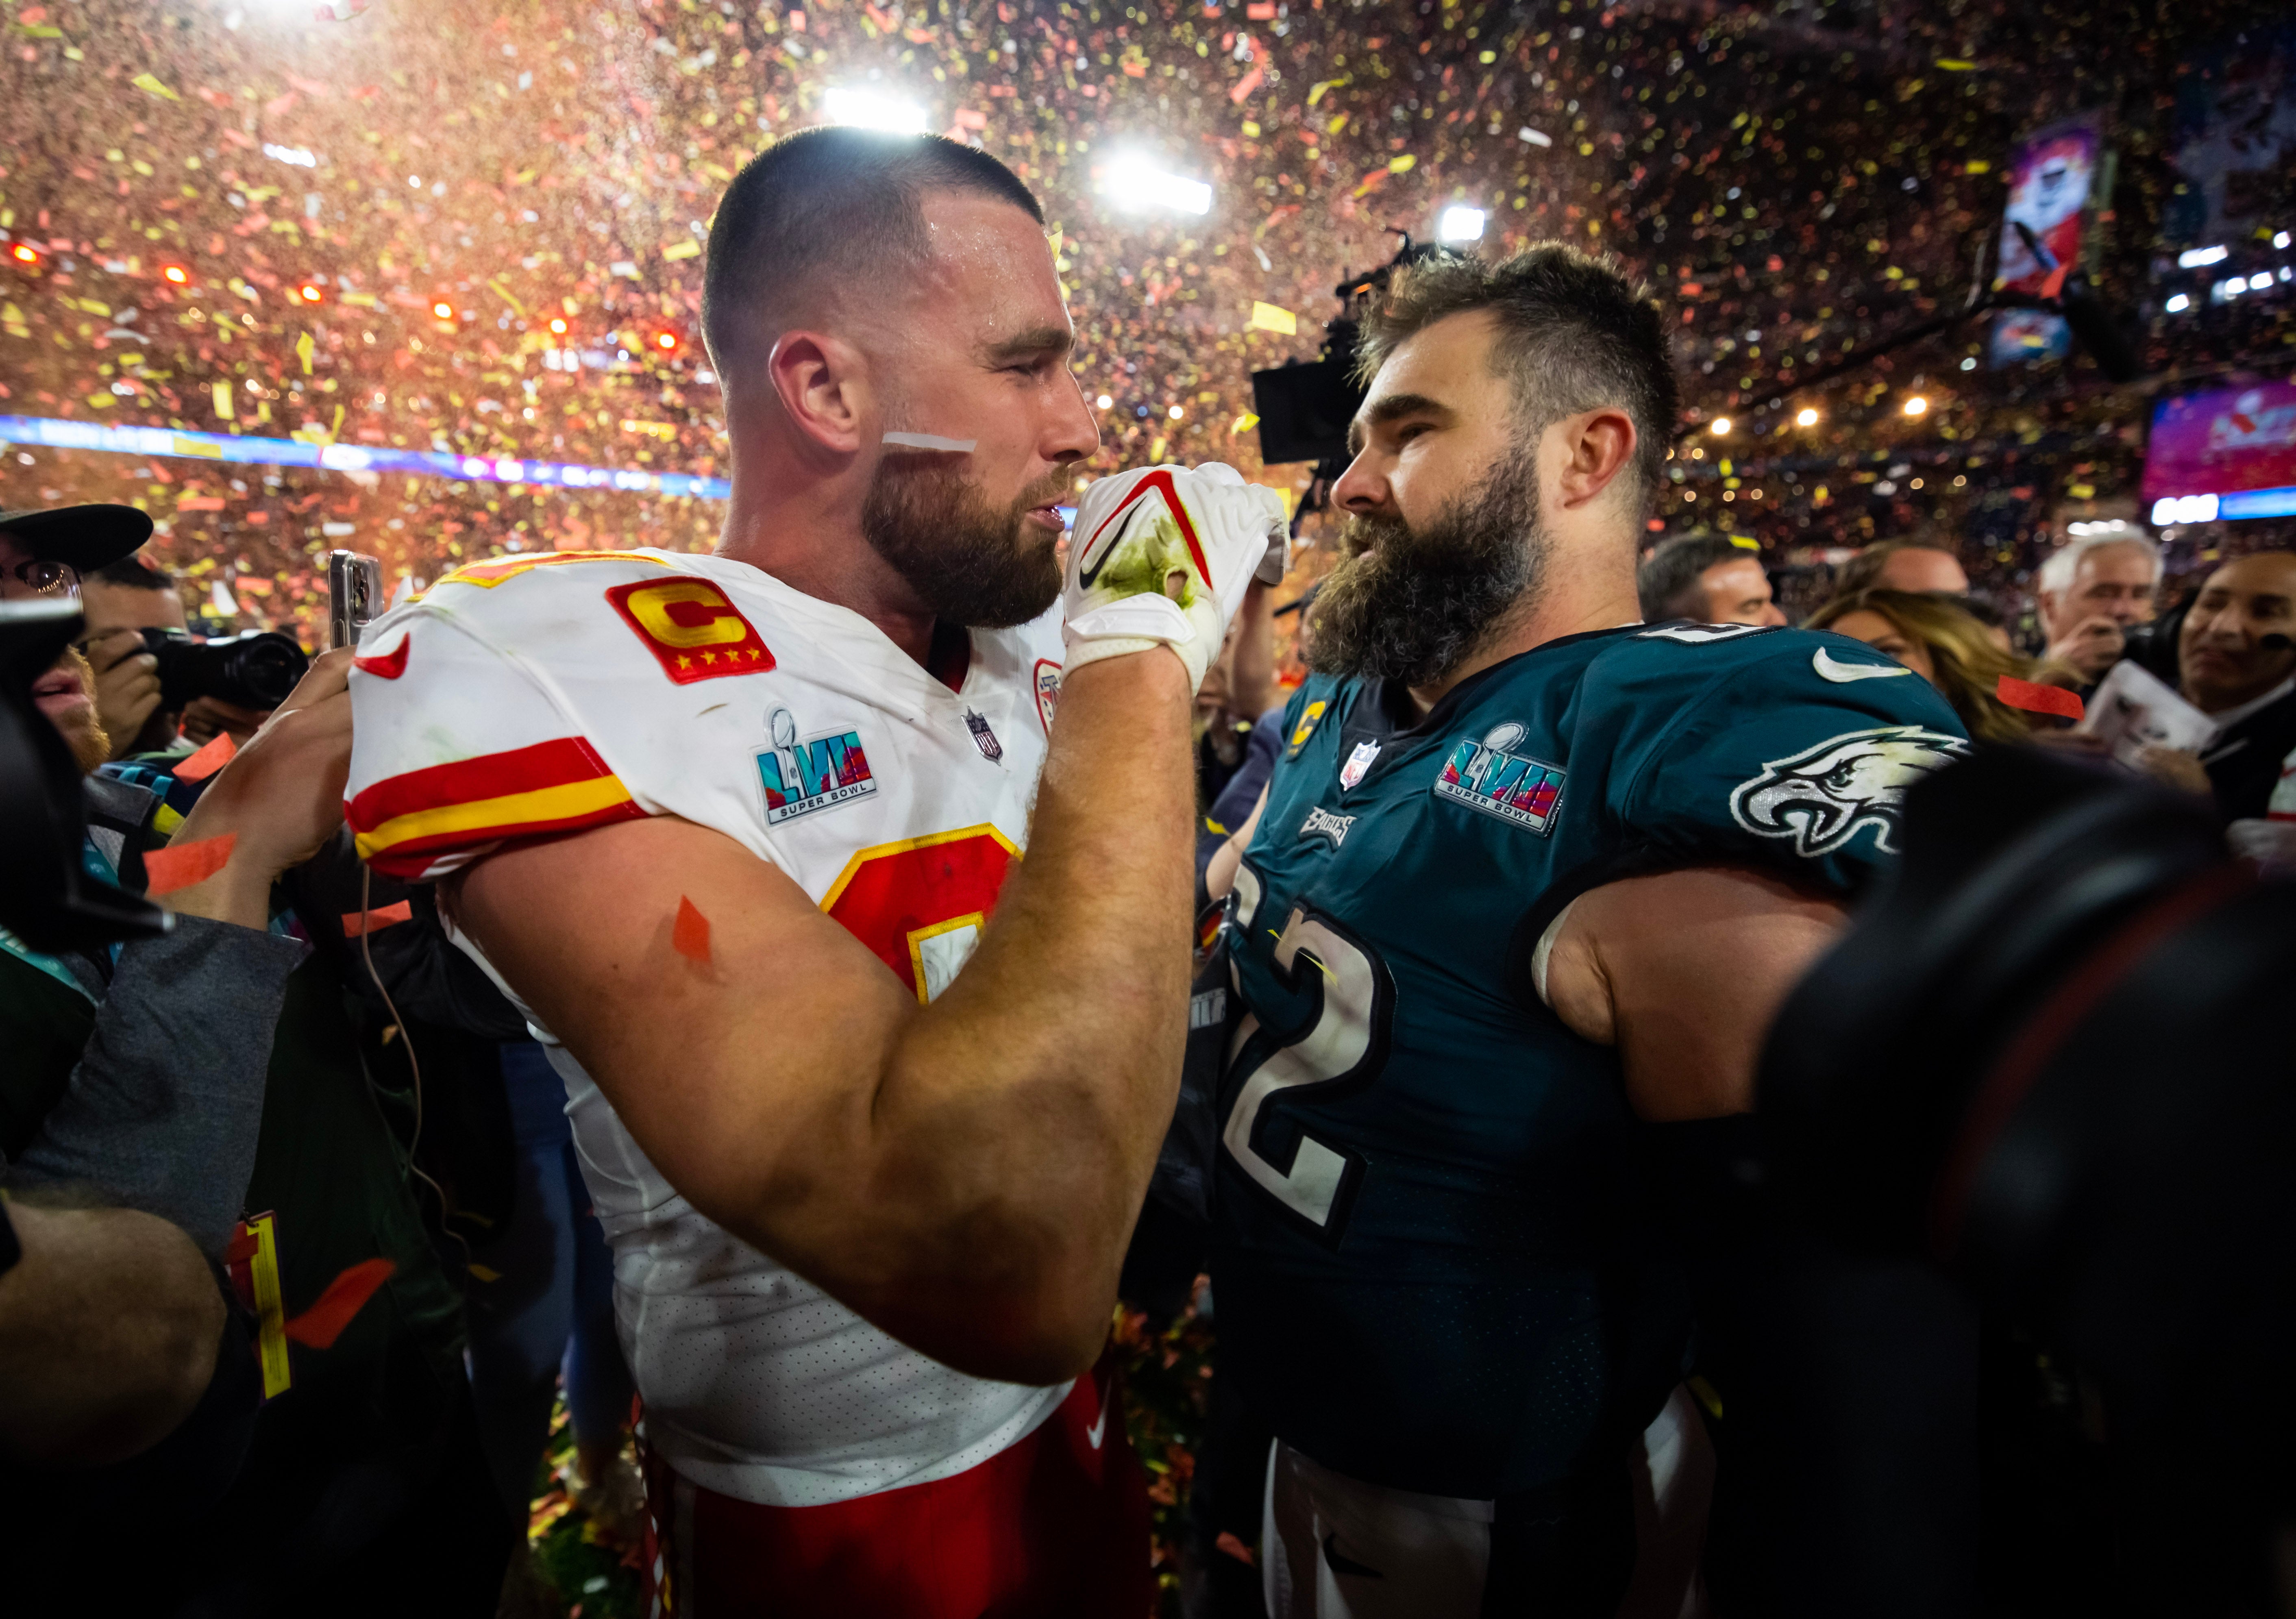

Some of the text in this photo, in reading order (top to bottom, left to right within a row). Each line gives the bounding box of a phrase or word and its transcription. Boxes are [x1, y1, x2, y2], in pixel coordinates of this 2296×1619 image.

[627, 582, 746, 648] C
[1292, 701, 1326, 745] C
[757, 731, 873, 810] LVII
[1443, 741, 1566, 819] LVII
[781, 783, 866, 817] SUPER BOWL
[1447, 785, 1532, 823] SUPER BOWL
[1299, 806, 1357, 846] EAGLES
